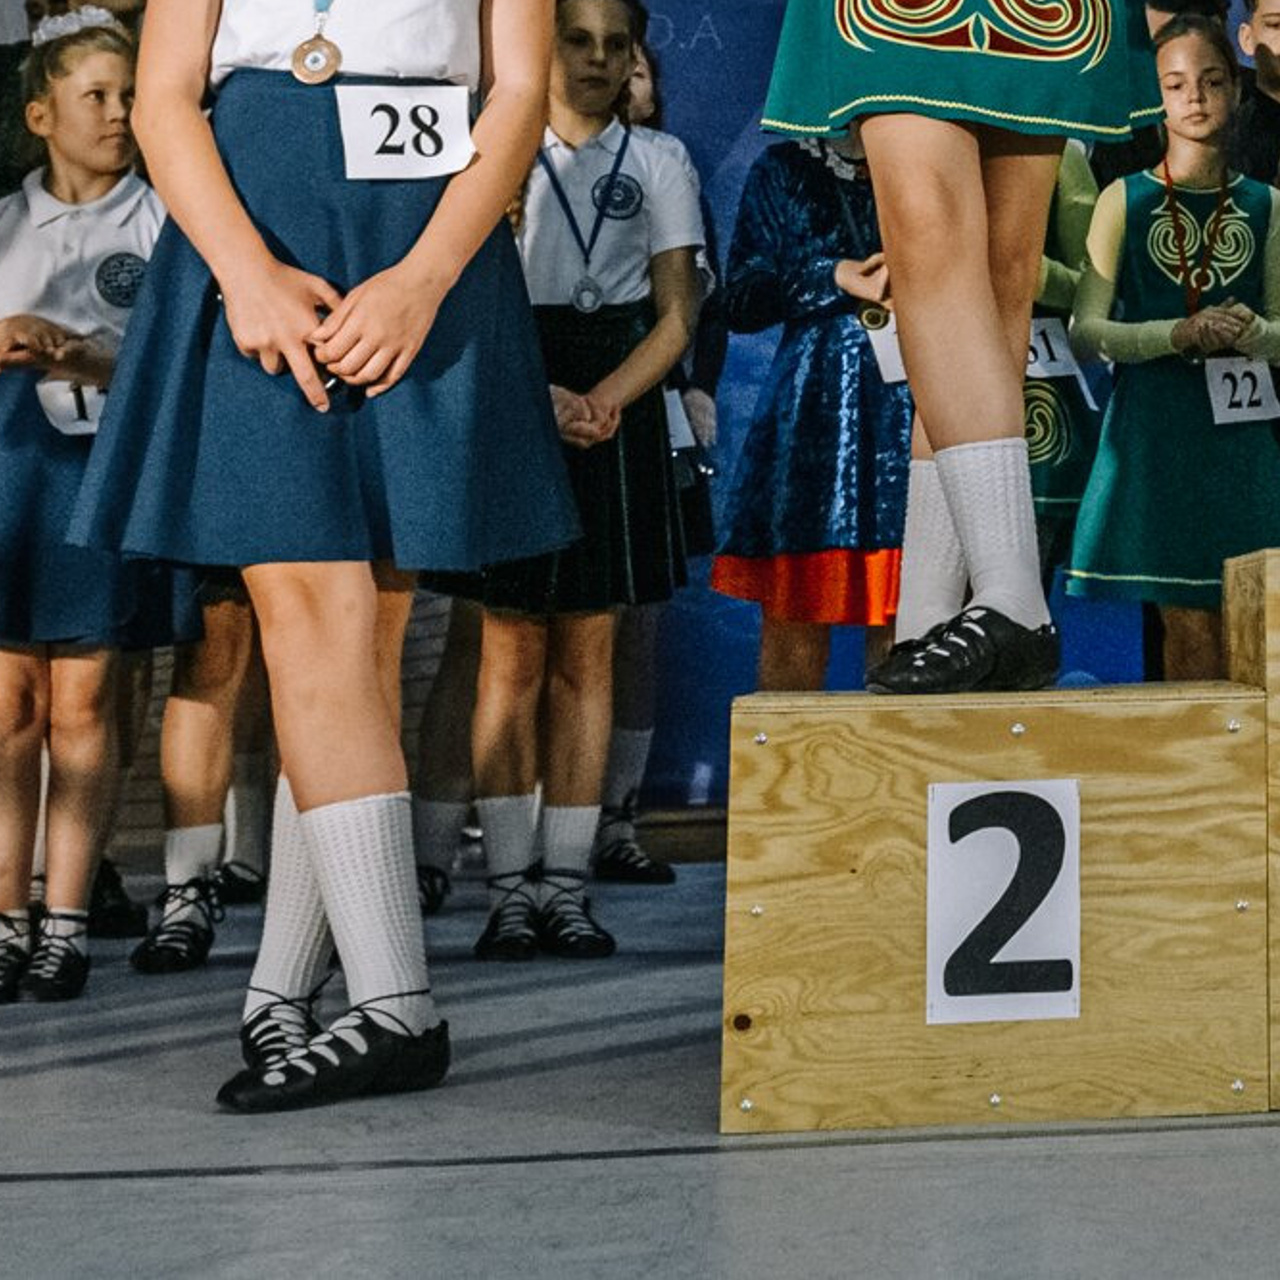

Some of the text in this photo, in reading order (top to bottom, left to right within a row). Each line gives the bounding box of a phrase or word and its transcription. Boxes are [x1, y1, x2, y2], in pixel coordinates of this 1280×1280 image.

[371, 103, 443, 157] 28
[1221, 370, 1263, 410] 22
[943, 790, 1074, 997] 2
